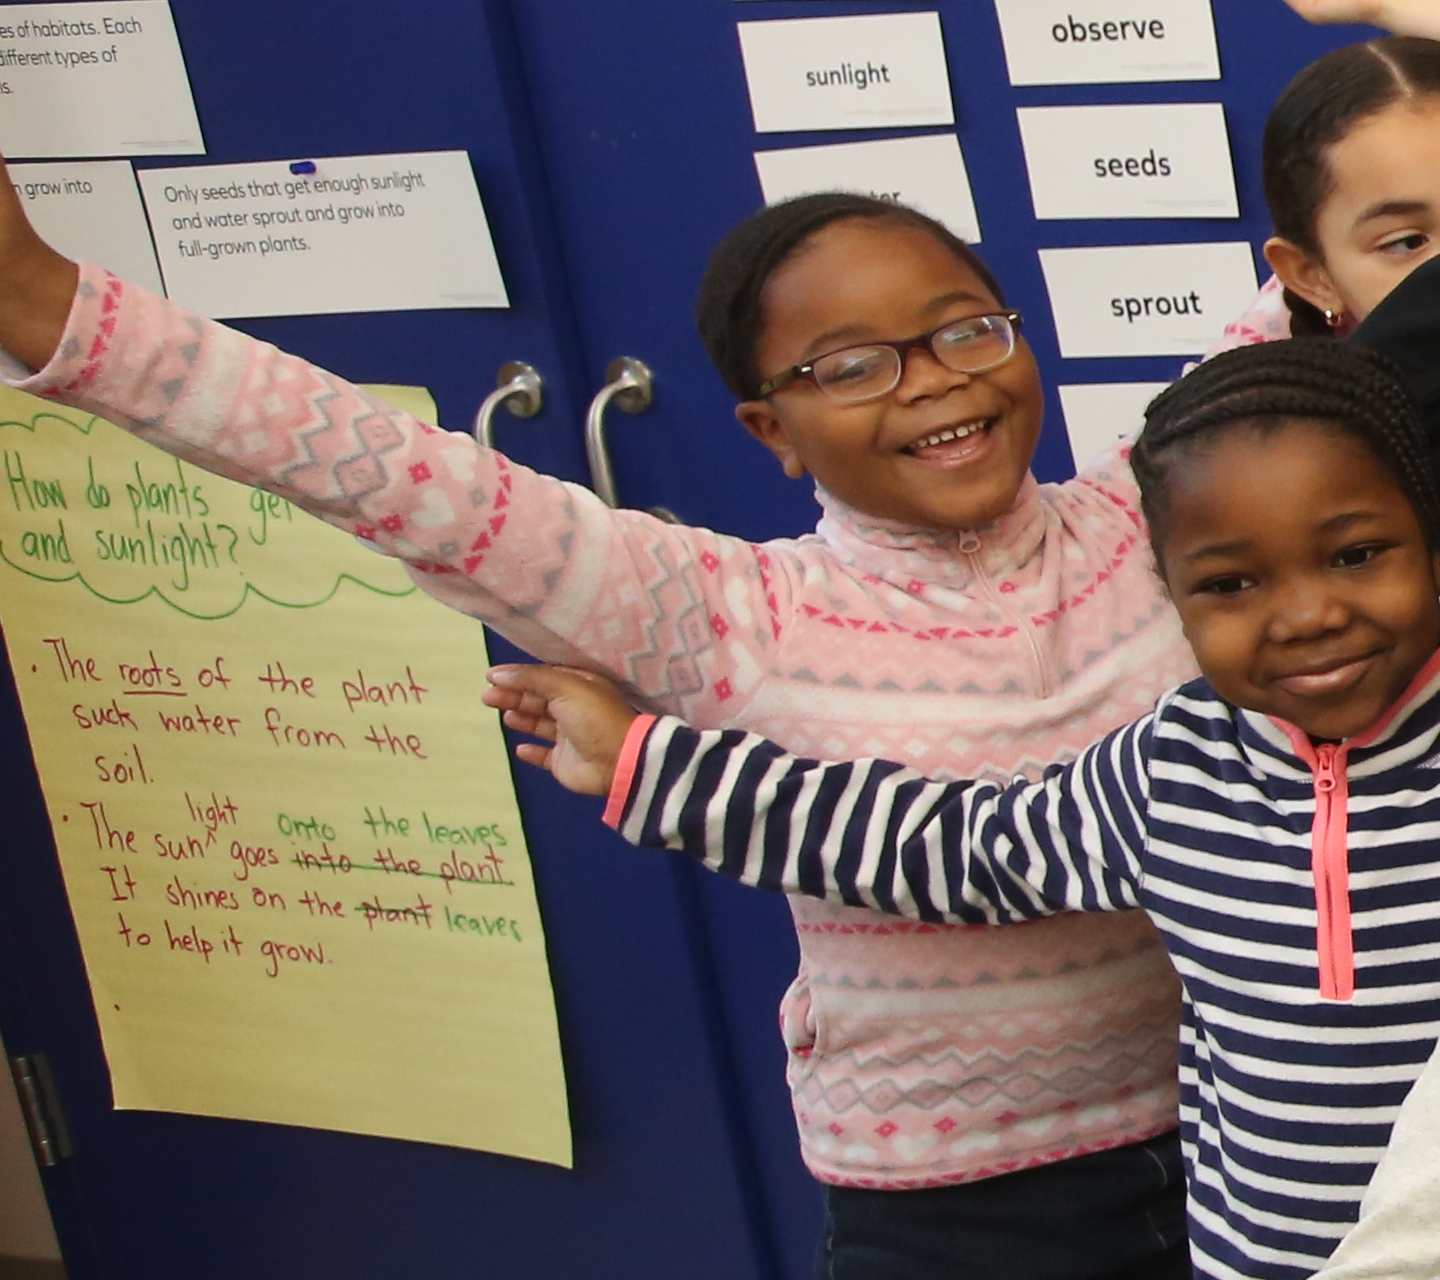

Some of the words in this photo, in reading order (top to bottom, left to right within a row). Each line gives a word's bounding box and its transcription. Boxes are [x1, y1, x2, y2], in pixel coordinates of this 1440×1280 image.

[18, 22, 30, 37] of
[33, 20, 100, 36] habitats.
[104, 18, 142, 34] Each
[1051, 15, 1165, 44] observe
[54, 50, 98, 69] types
[102, 45, 117, 62] of
[805, 64, 890, 89] sunlight
[1094, 149, 1171, 176] seeds
[26, 181, 62, 198] grow
[63, 178, 92, 195] into
[164, 185, 199, 203] Only
[202, 183, 246, 200] seeds
[248, 181, 282, 197] that
[285, 180, 312, 199] get
[314, 174, 369, 195] enough
[371, 170, 425, 192] sunlight
[172, 212, 202, 230] and
[204, 211, 248, 227] water
[253, 207, 302, 228] sprout
[305, 204, 334, 221] and
[338, 206, 374, 221] grow
[377, 202, 405, 217] into
[178, 239, 256, 260] full-grown
[259, 235, 311, 256] plants.
[1110, 292, 1202, 322] sprout
[5, 452, 65, 514] How
[86, 457, 110, 508] do
[127, 463, 209, 522] plants
[22, 520, 73, 563] and
[96, 522, 240, 590] sunlight?
[44, 639, 102, 682] The
[119, 651, 186, 694] roots
[258, 663, 316, 698] the
[342, 666, 429, 709] plant
[73, 705, 138, 730] suck
[160, 710, 241, 738] water
[266, 709, 345, 748] from
[364, 724, 427, 760] the
[96, 745, 154, 785] soil.
[186, 794, 238, 830] light
[278, 812, 335, 836] onto
[364, 807, 409, 838] the
[422, 812, 507, 847] leaves
[80, 802, 137, 853] The
[156, 830, 201, 858] sun
[230, 843, 279, 880] goes
[166, 882, 240, 911] shines
[298, 894, 345, 919] the
[445, 908, 522, 941] leaves
[166, 922, 213, 961] help
[261, 943, 332, 977] grow.
